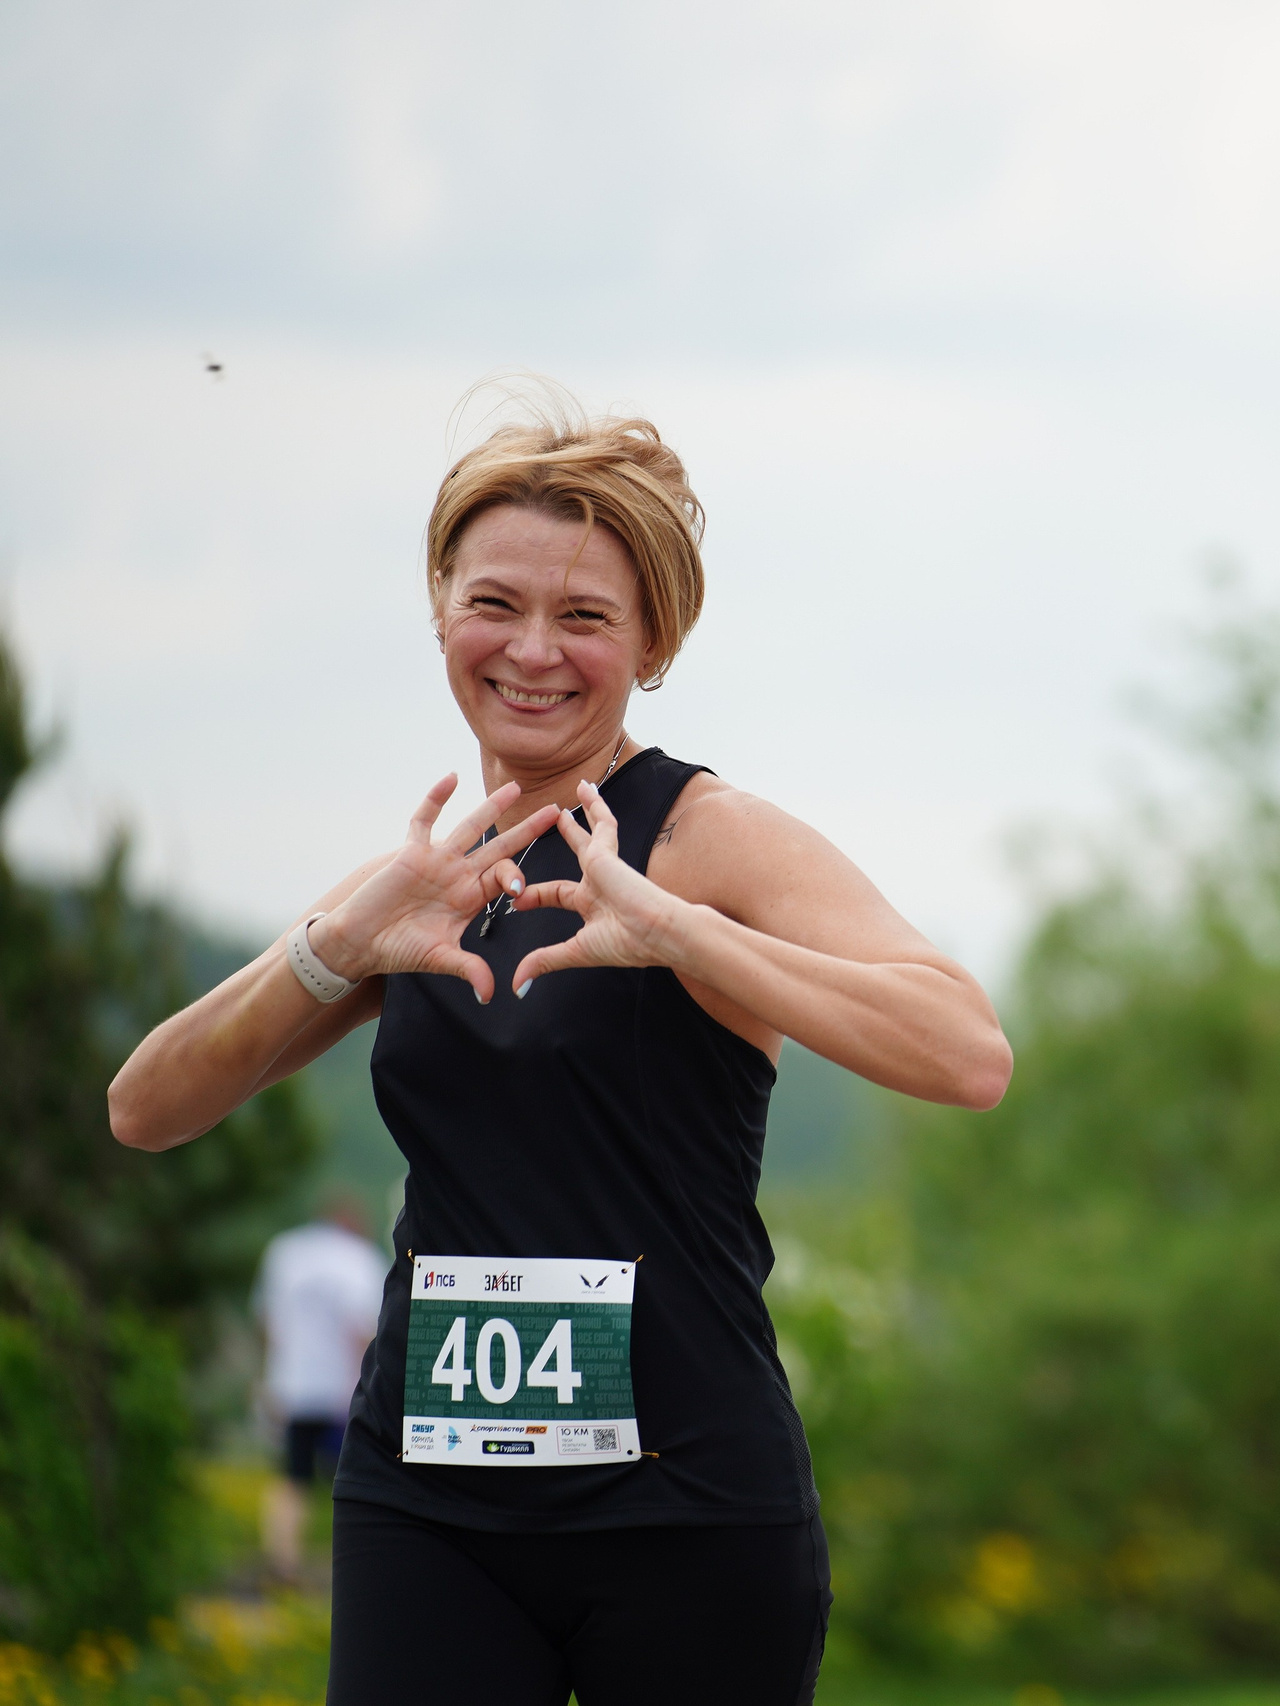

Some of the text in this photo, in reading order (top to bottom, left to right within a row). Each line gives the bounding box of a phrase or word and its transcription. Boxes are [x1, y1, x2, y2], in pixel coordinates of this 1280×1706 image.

[436, 1274, 455, 1287] ПСБ
[484, 1273, 523, 1291] ЗАБЕГ
[431, 1316, 582, 1404] 404
[411, 1424, 435, 1433] СИБУР
[561, 1428, 571, 1436] 10
